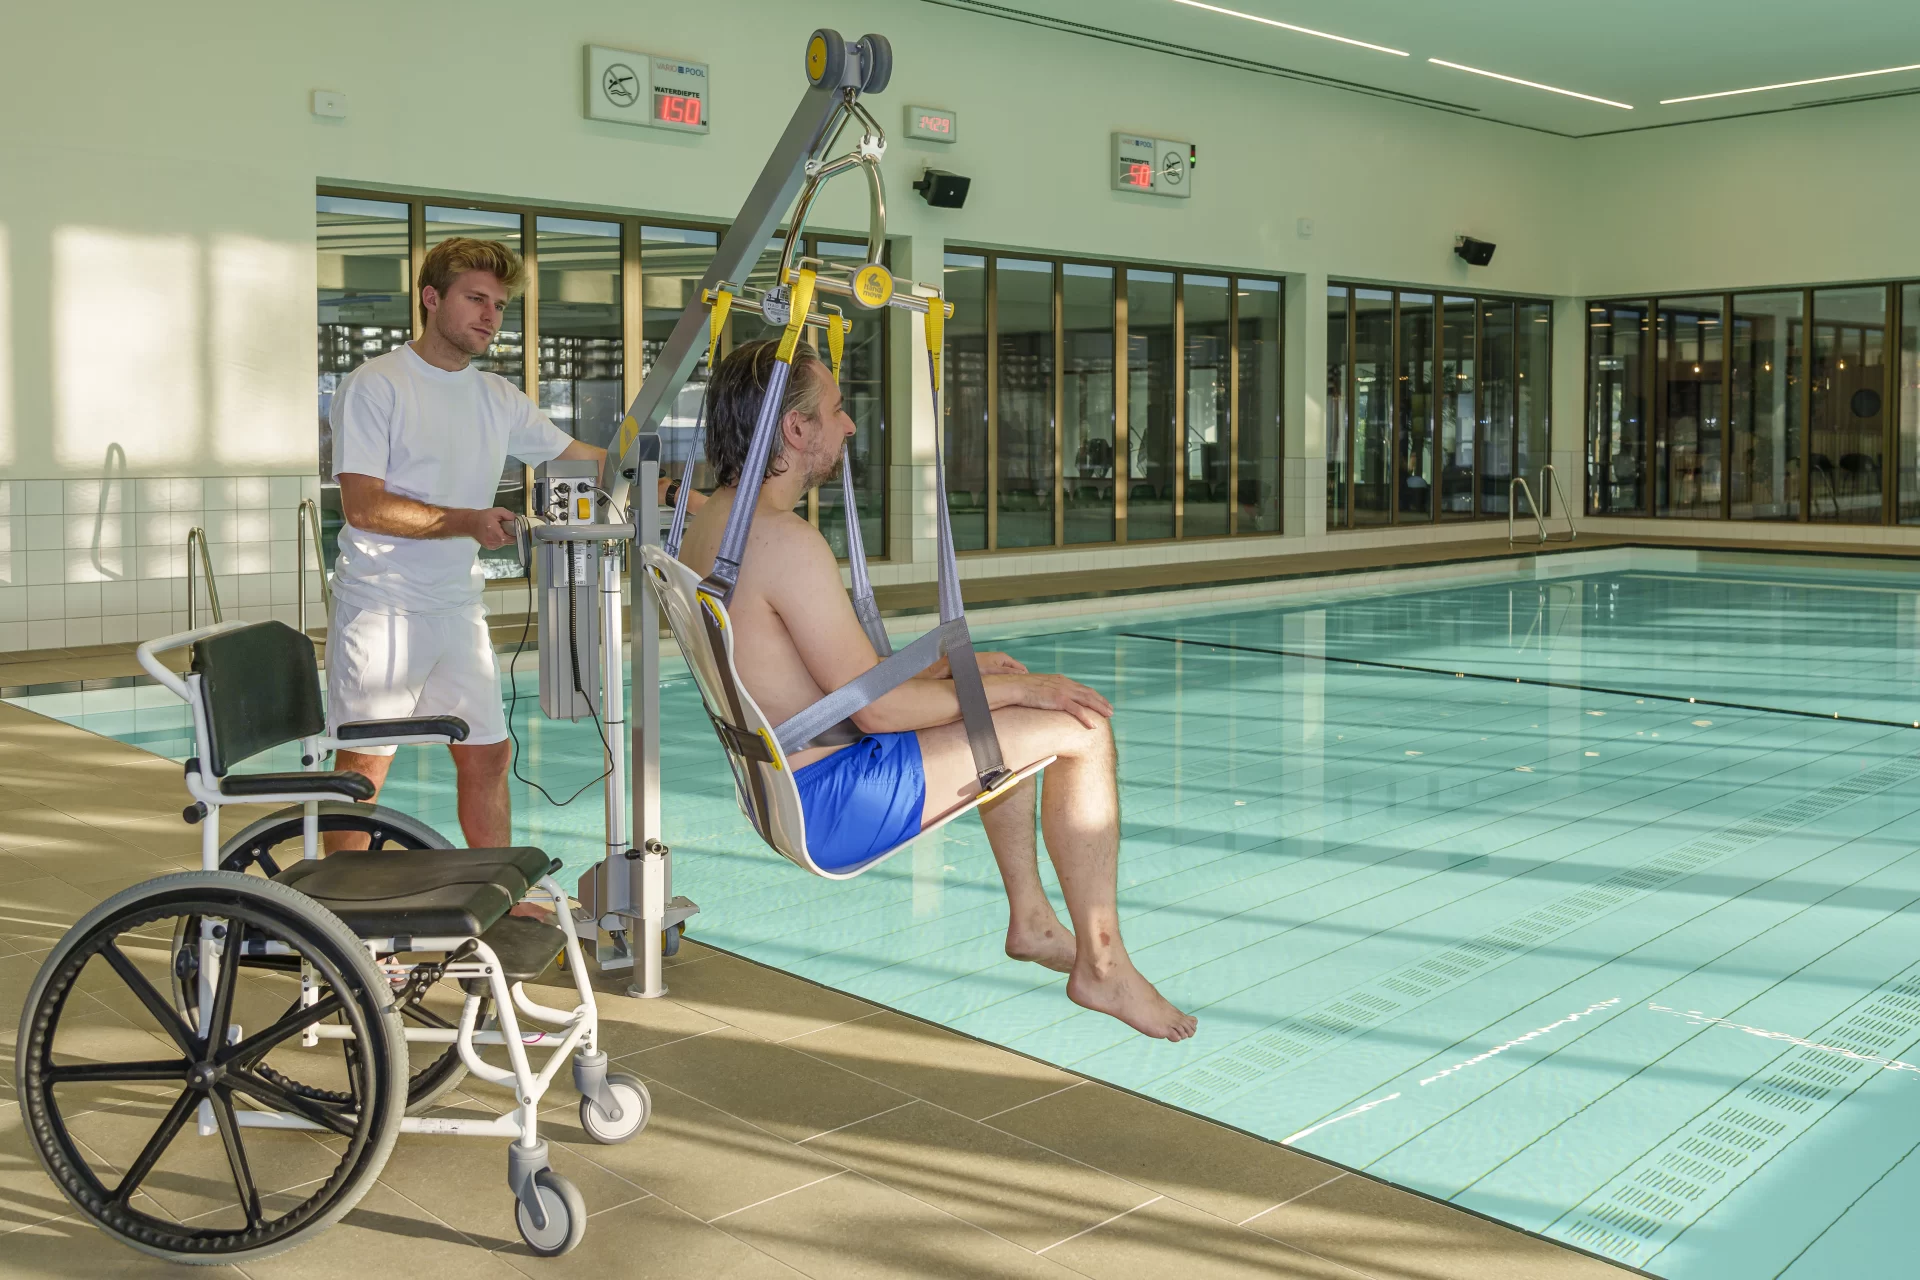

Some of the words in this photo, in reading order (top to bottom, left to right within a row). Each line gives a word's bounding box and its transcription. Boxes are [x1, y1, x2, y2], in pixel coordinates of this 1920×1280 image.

[656, 62, 677, 73] VARIO
[685, 67, 705, 78] POOL
[654, 86, 700, 98] WATERDIEPTE
